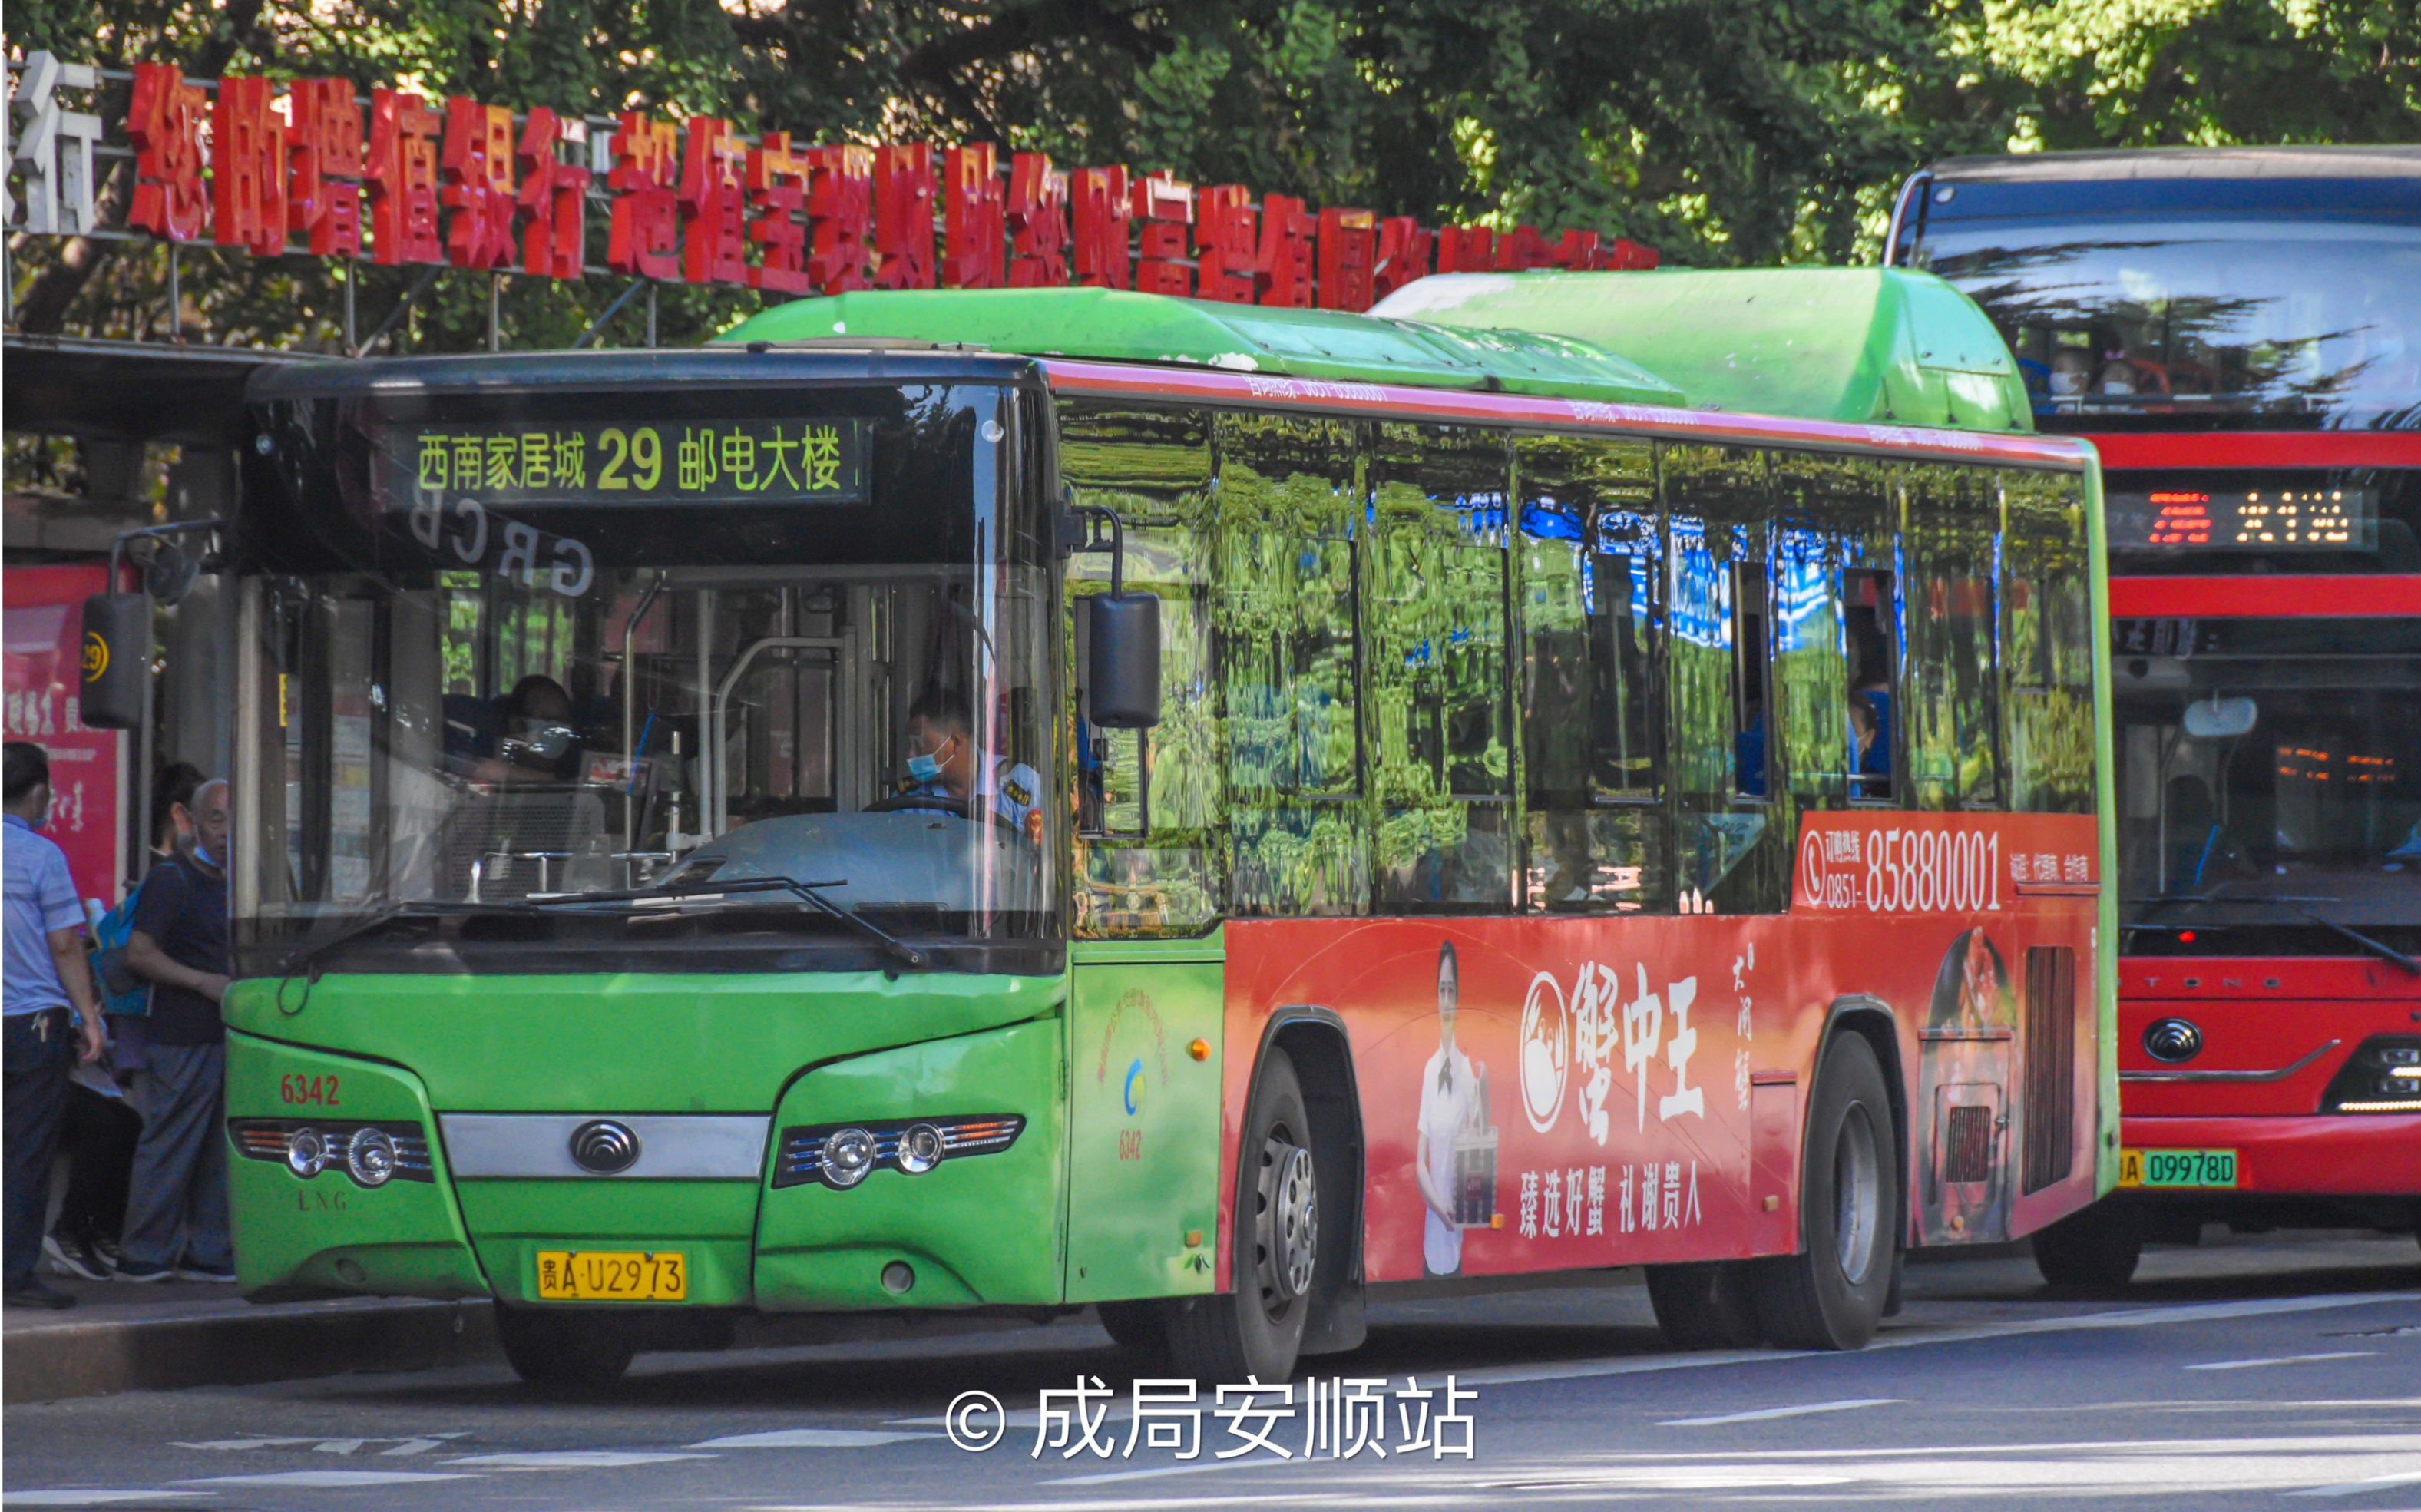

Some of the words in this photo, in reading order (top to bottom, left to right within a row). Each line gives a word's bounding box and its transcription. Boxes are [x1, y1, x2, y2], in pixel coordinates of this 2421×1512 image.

[418, 432, 586, 490] 西南家居城
[597, 427, 663, 491] 29
[678, 425, 842, 492] 邮电大楼
[1866, 827, 2001, 912] 85880001
[1570, 960, 1704, 1147] 蟹中王
[281, 1074, 340, 1106] 6342
[1119, 1130, 1142, 1160] 6342
[297, 1190, 347, 1212] LNG
[1520, 1165, 1606, 1239] 臻选好蟹
[1619, 1160, 1702, 1233] 礼谢贵人
